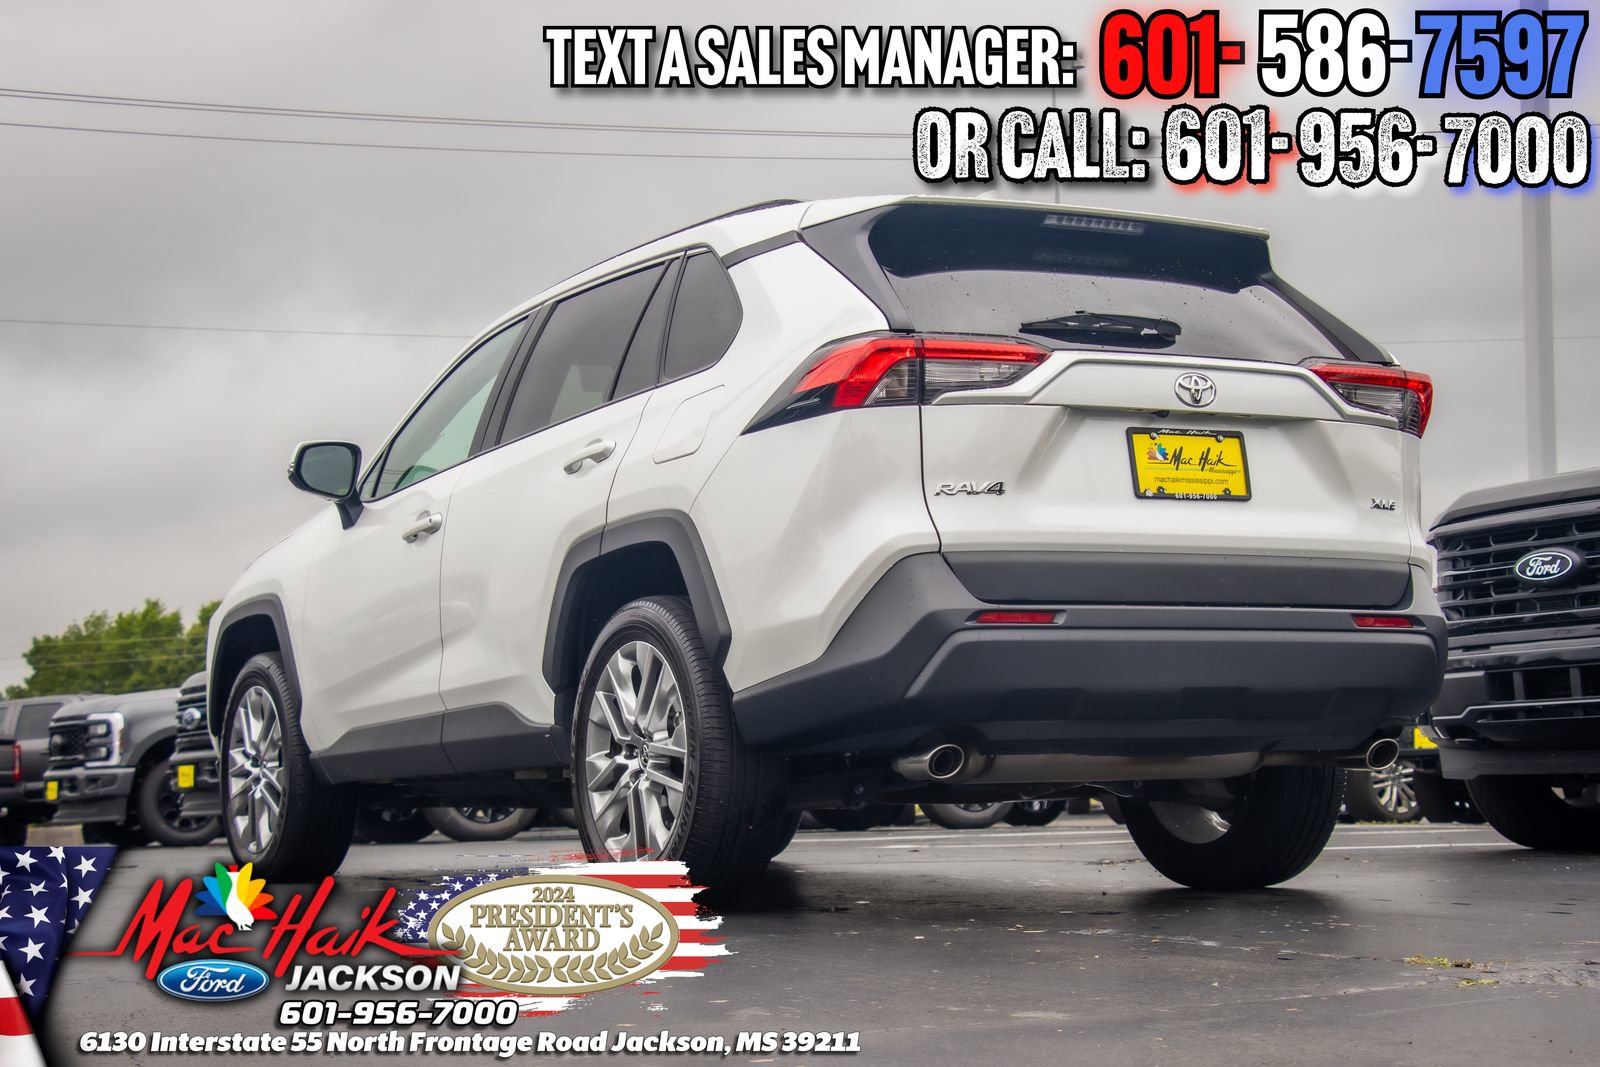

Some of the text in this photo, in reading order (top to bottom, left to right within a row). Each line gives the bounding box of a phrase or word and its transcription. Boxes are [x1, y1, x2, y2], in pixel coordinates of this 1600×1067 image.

[1168, 446, 1238, 472] Mac Haik
[934, 480, 1005, 496] RAV4
[1154, 476, 1229, 485] machaikmississippi.com
[1525, 555, 1561, 577] Ford
